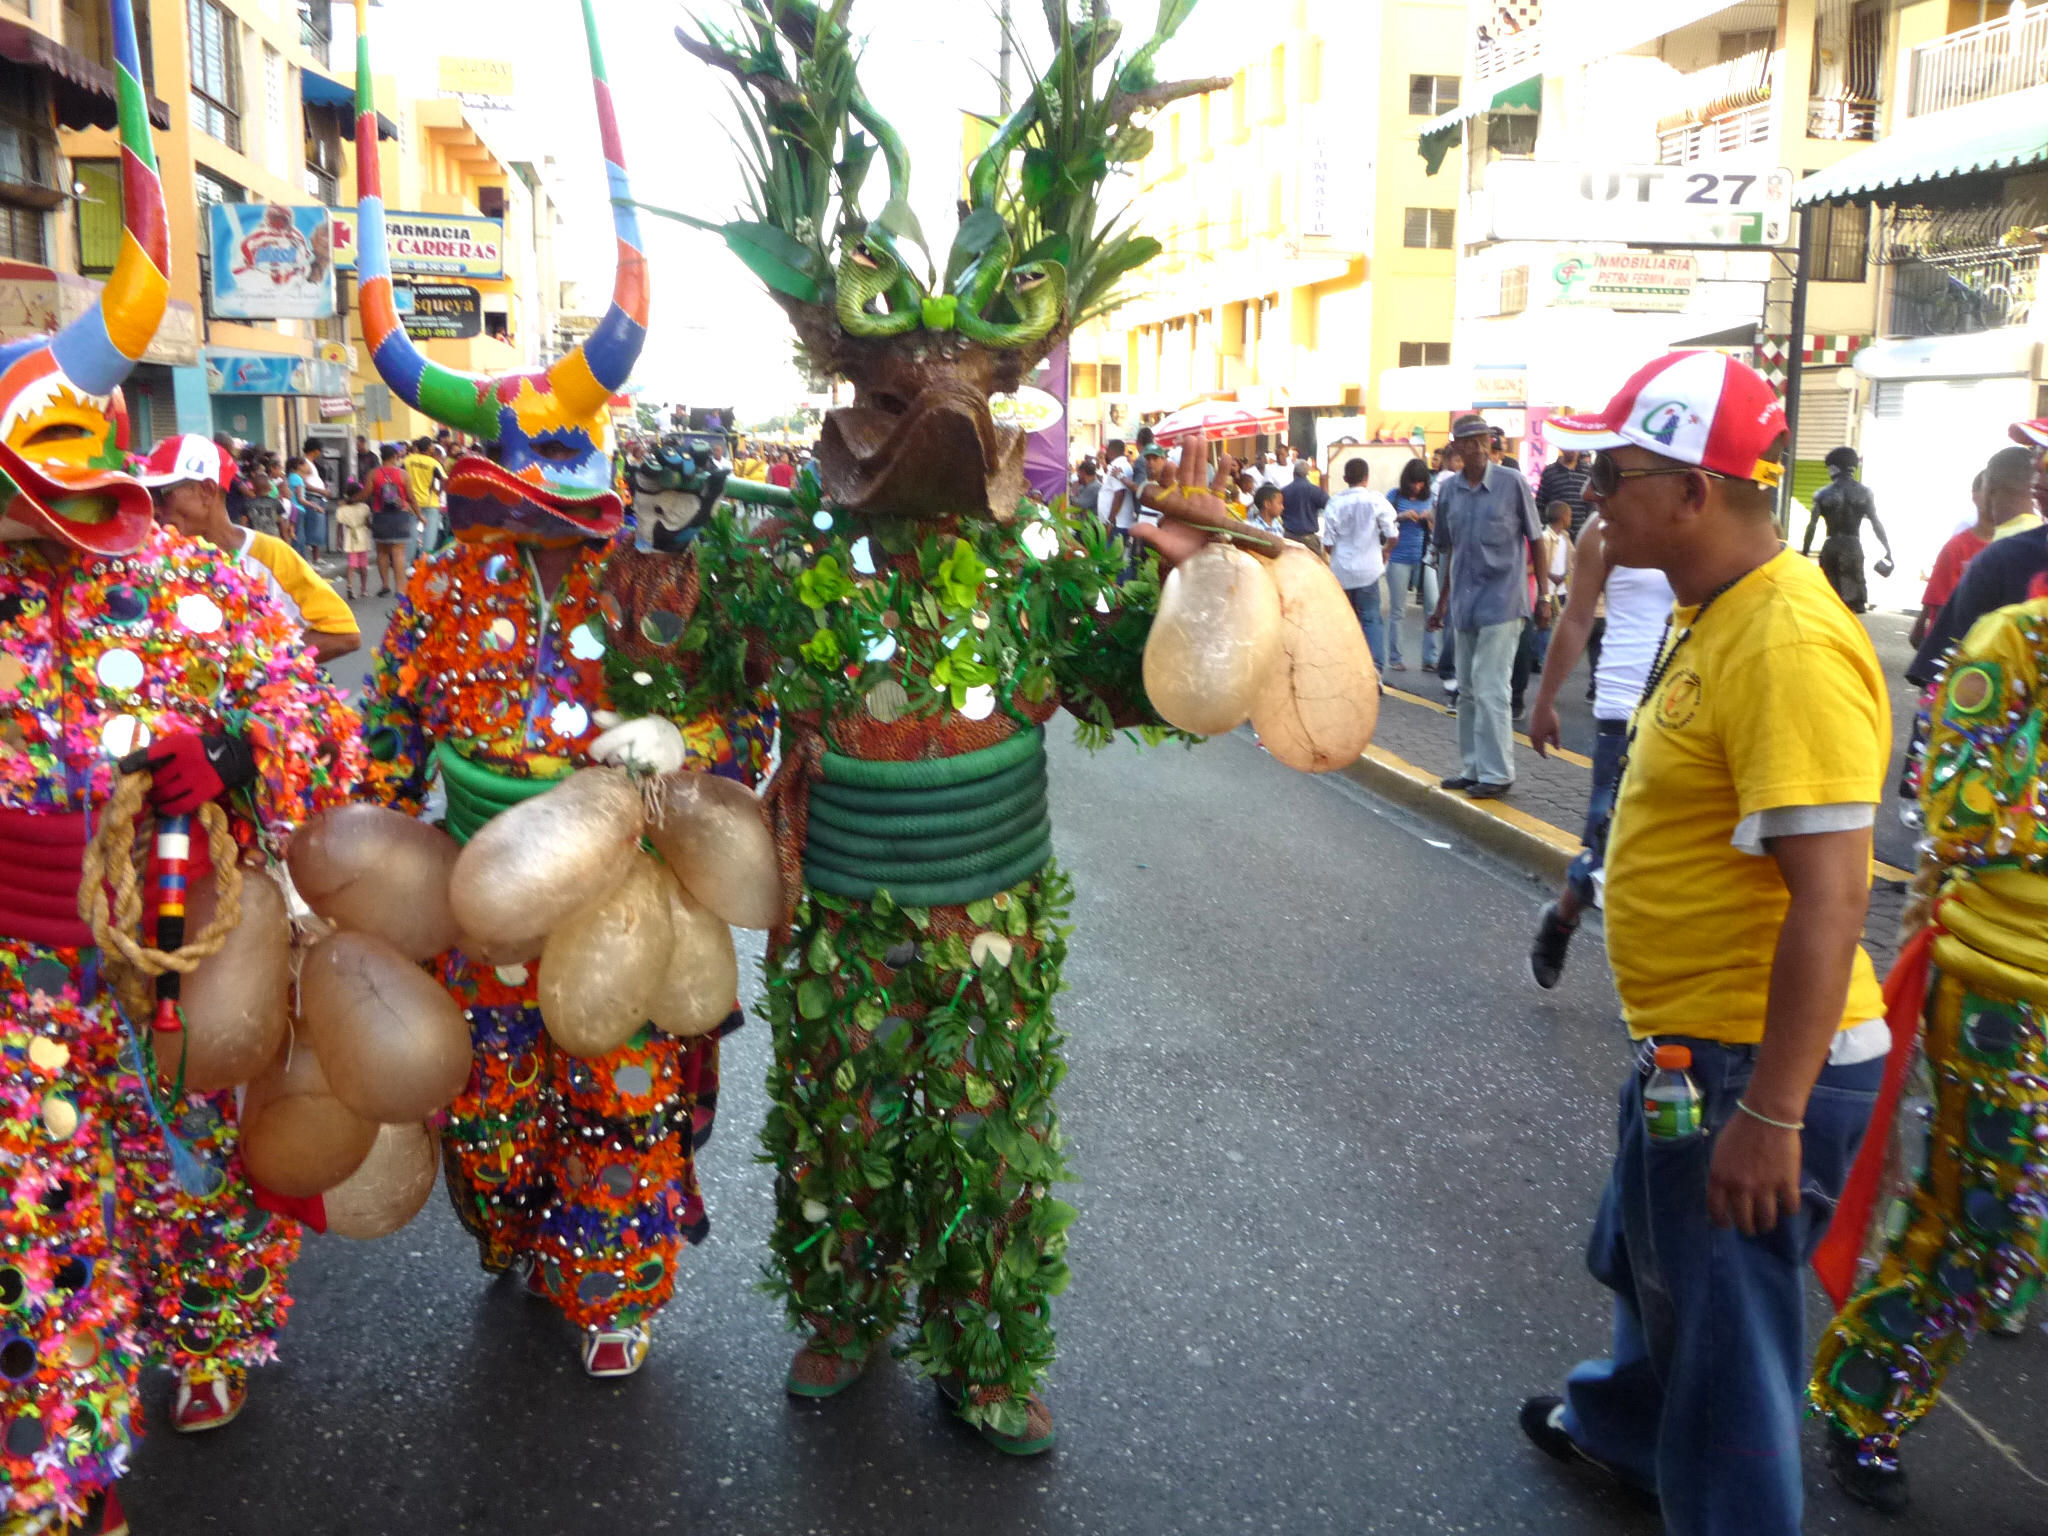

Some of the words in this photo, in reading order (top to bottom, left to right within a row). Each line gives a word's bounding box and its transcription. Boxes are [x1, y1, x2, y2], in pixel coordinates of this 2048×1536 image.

[1684, 173, 1757, 205] 27
[386, 223, 471, 240] FARMACIA
[396, 238, 497, 260] CARRERAS
[1593, 255, 1691, 271] INMOBILIARIA
